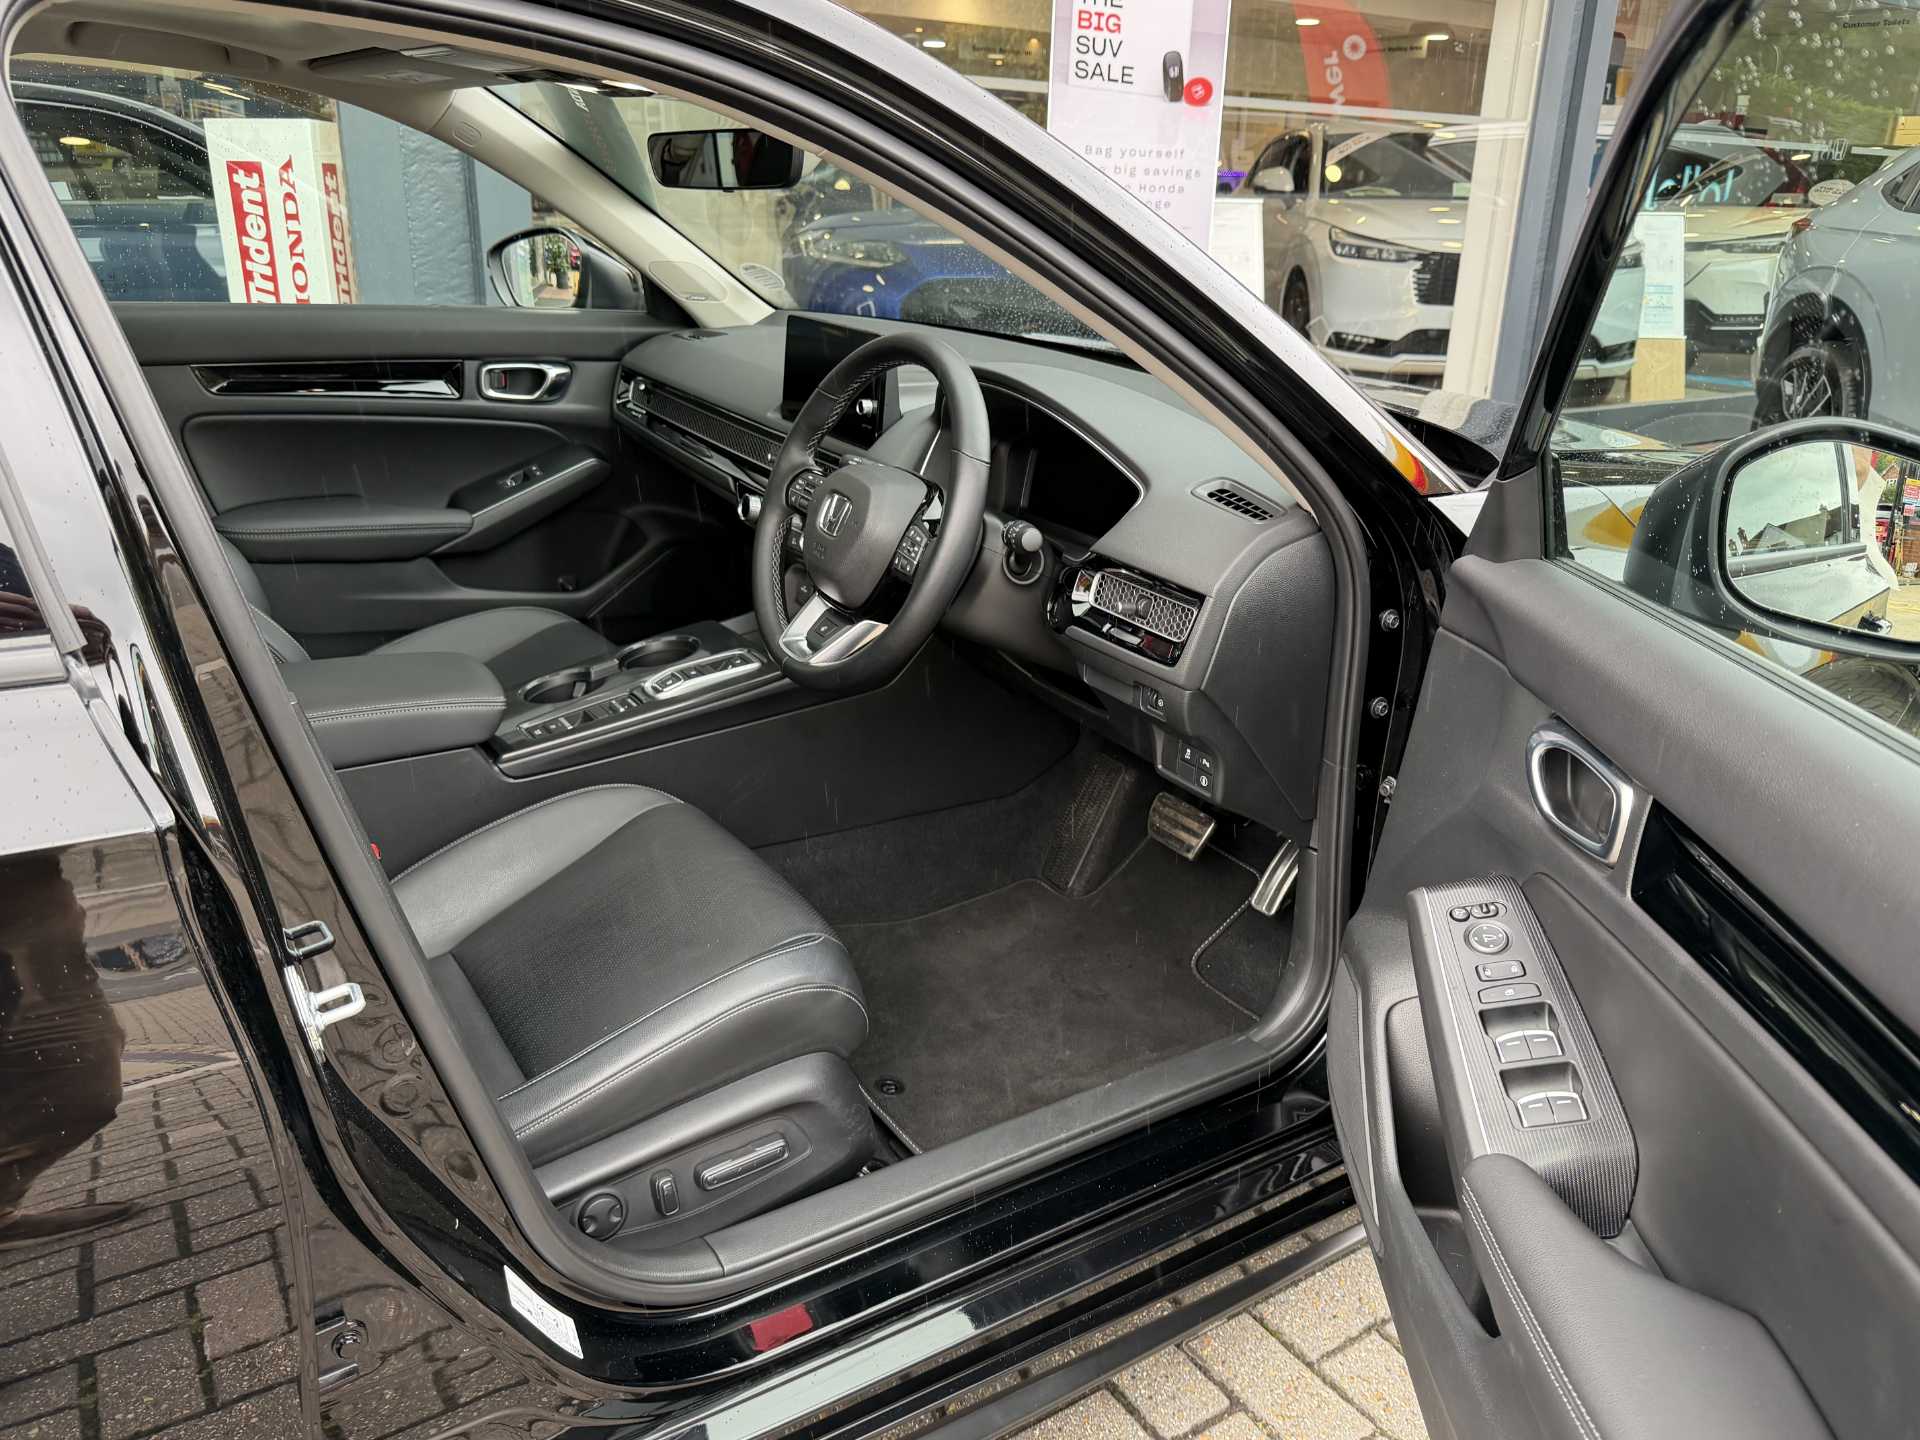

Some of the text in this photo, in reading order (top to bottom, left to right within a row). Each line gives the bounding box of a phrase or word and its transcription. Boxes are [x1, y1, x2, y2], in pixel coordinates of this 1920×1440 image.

[1077, 10, 1121, 33] BIG
[1076, 35, 1123, 57] SUV
[1074, 60, 1134, 84] SALE
[1085, 145, 1184, 159] Bag yourself
[1113, 164, 1201, 180] big savings
[1138, 183, 1185, 194] Honda
[232, 168, 276, 304] Trident
